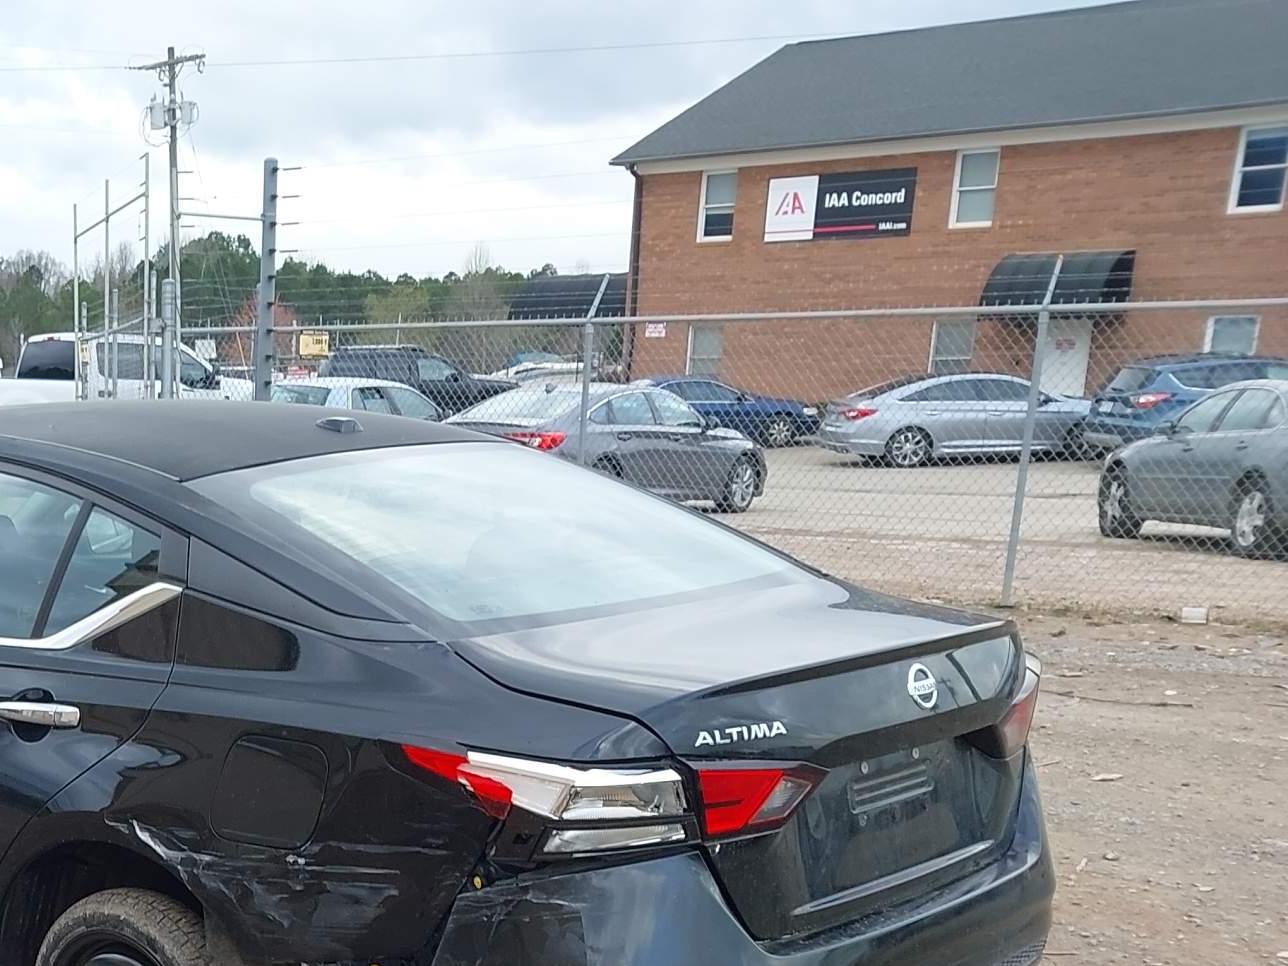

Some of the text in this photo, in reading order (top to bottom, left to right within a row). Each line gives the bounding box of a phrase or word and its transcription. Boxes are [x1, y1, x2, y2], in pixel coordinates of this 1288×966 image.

[824, 187, 906, 209] IAA Concord
[694, 720, 788, 748] ALTIMA
